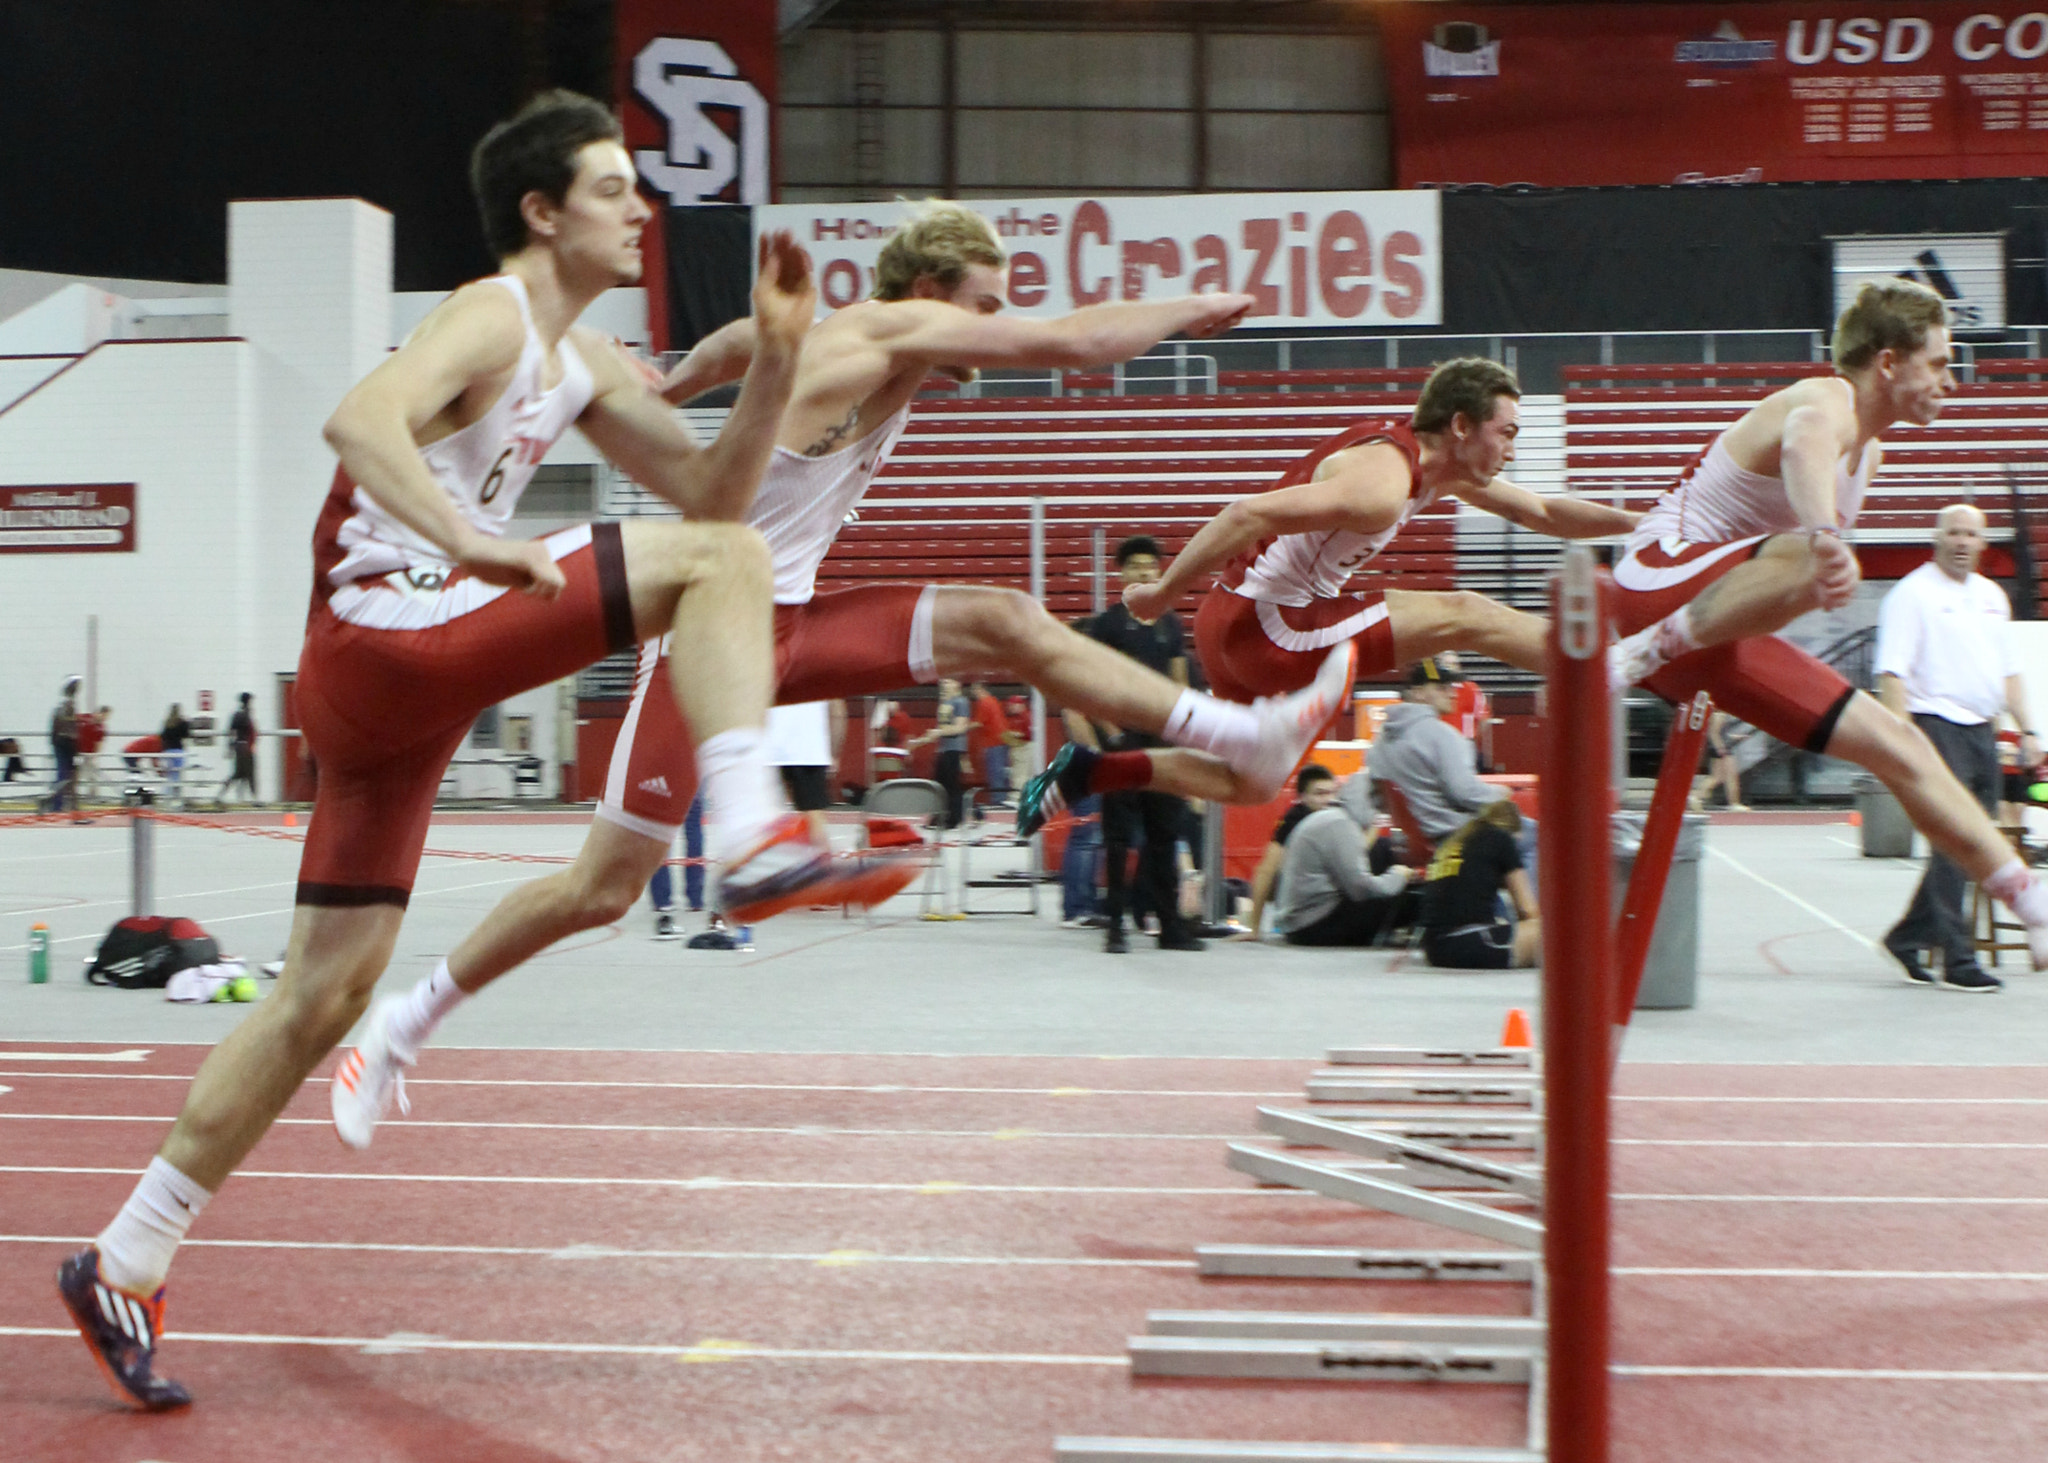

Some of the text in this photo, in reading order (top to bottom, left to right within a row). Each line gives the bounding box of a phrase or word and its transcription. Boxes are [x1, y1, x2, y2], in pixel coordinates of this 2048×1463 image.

[1786, 18, 1933, 64] USD
[997, 207, 1060, 236] the
[1067, 199, 1425, 318] Crazies
[481, 447, 513, 505] 6
